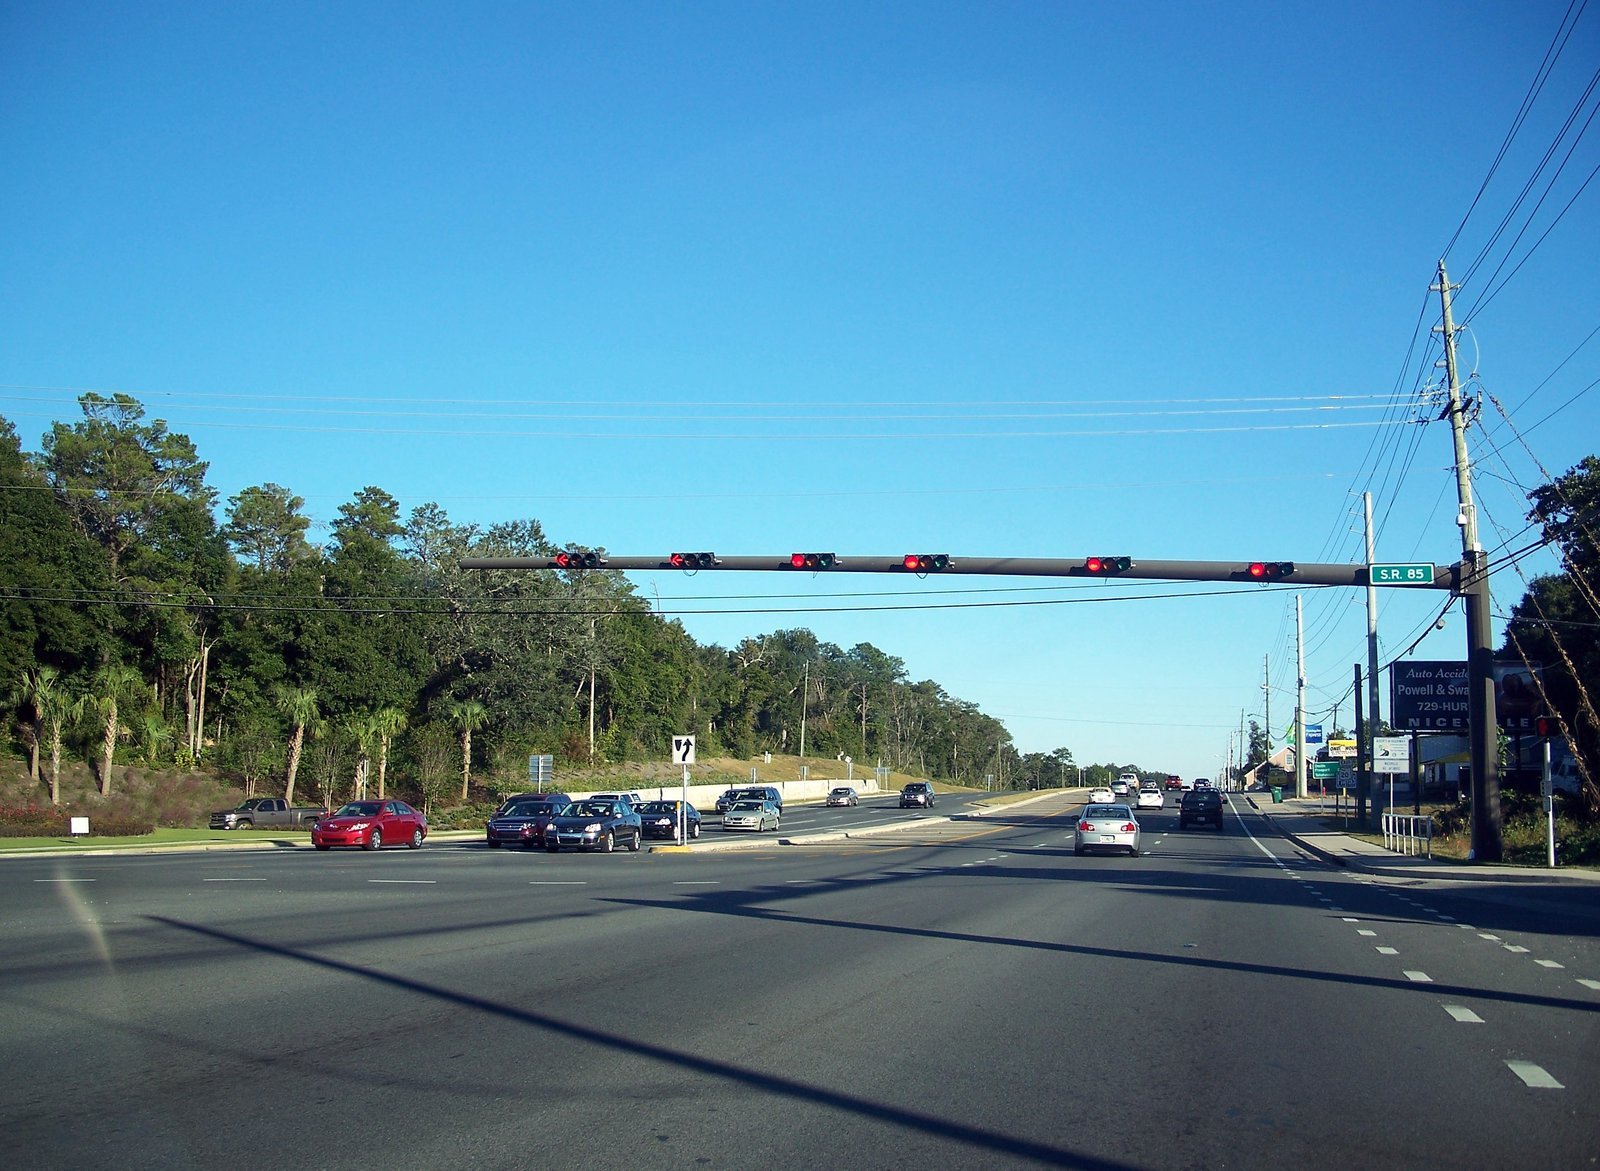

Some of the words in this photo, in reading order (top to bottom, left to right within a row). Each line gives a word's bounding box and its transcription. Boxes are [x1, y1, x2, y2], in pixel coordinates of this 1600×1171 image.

[1380, 569, 1402, 580] S.R.
[1407, 568, 1424, 579] 85
[1406, 668, 1432, 678] Auto
[1397, 684, 1433, 695] Powell
[1436, 684, 1445, 695] &
[1416, 702, 1469, 711] 729-HUR
